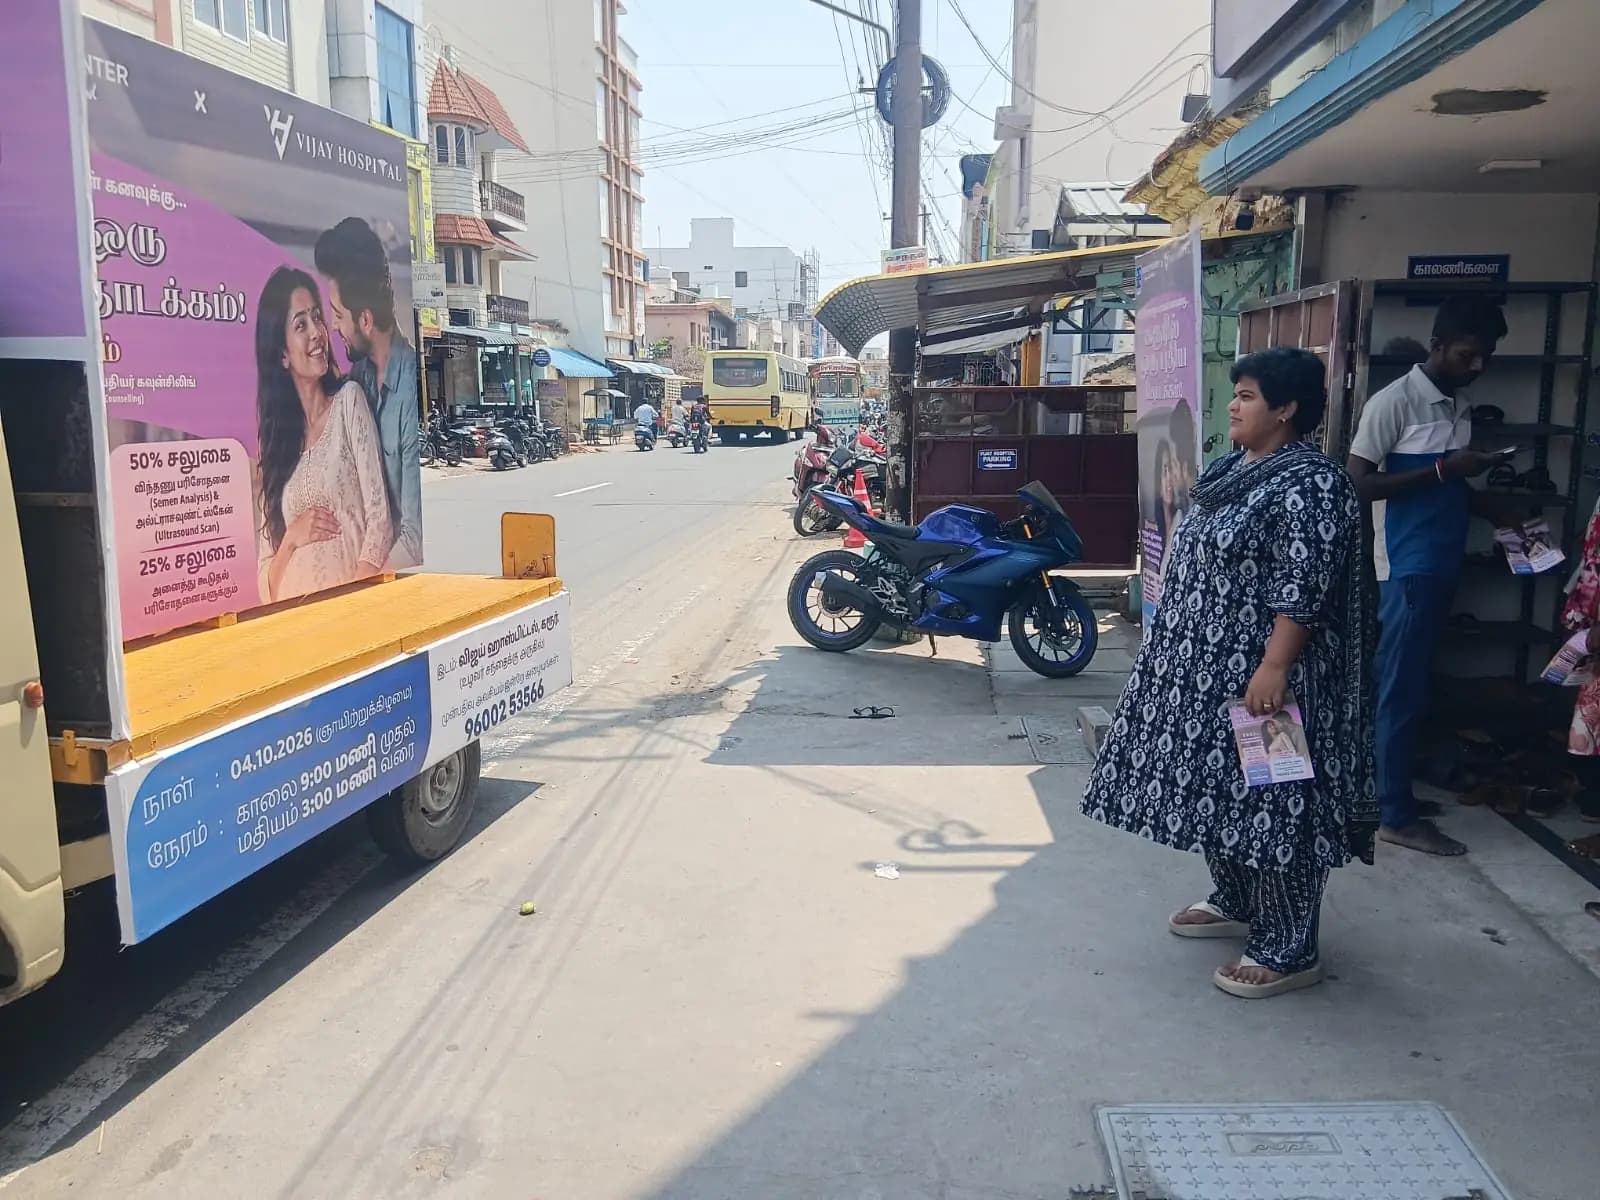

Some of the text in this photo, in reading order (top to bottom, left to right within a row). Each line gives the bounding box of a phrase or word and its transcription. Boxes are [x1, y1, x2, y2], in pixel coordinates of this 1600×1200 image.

[296, 131, 334, 159] VIJAY
[105, 178, 187, 211] கனவுக்கு...
[1414, 260, 1500, 275] காலணிகளை
[130, 448, 231, 474] 50% சலுகை
[134, 475, 230, 496] விந்தணு பரிசோதனை
[150, 497, 179, 511] (Semen
[180, 490, 213, 506] Analysis)
[155, 521, 220, 544] (Ultrasound Scan)
[140, 544, 237, 576] 25% சலுகை
[152, 579, 196, 598] அனைத்து
[459, 643, 486, 668] விஜய்
[464, 677, 545, 743] 96002 53566
[143, 775, 195, 825] நாள்
[230, 727, 314, 780] 04.10.2026
[316, 685, 413, 744] (ஞாயிற்றுக்கிழமை)
[147, 819, 208, 869] நேரம்
[236, 779, 298, 825] காலை
[300, 760, 332, 792] 9:00
[335, 732, 377, 773] மணி
[380, 716, 416, 755] முதல்
[238, 742, 415, 853] மதியம் 3:00 மணி வரை
